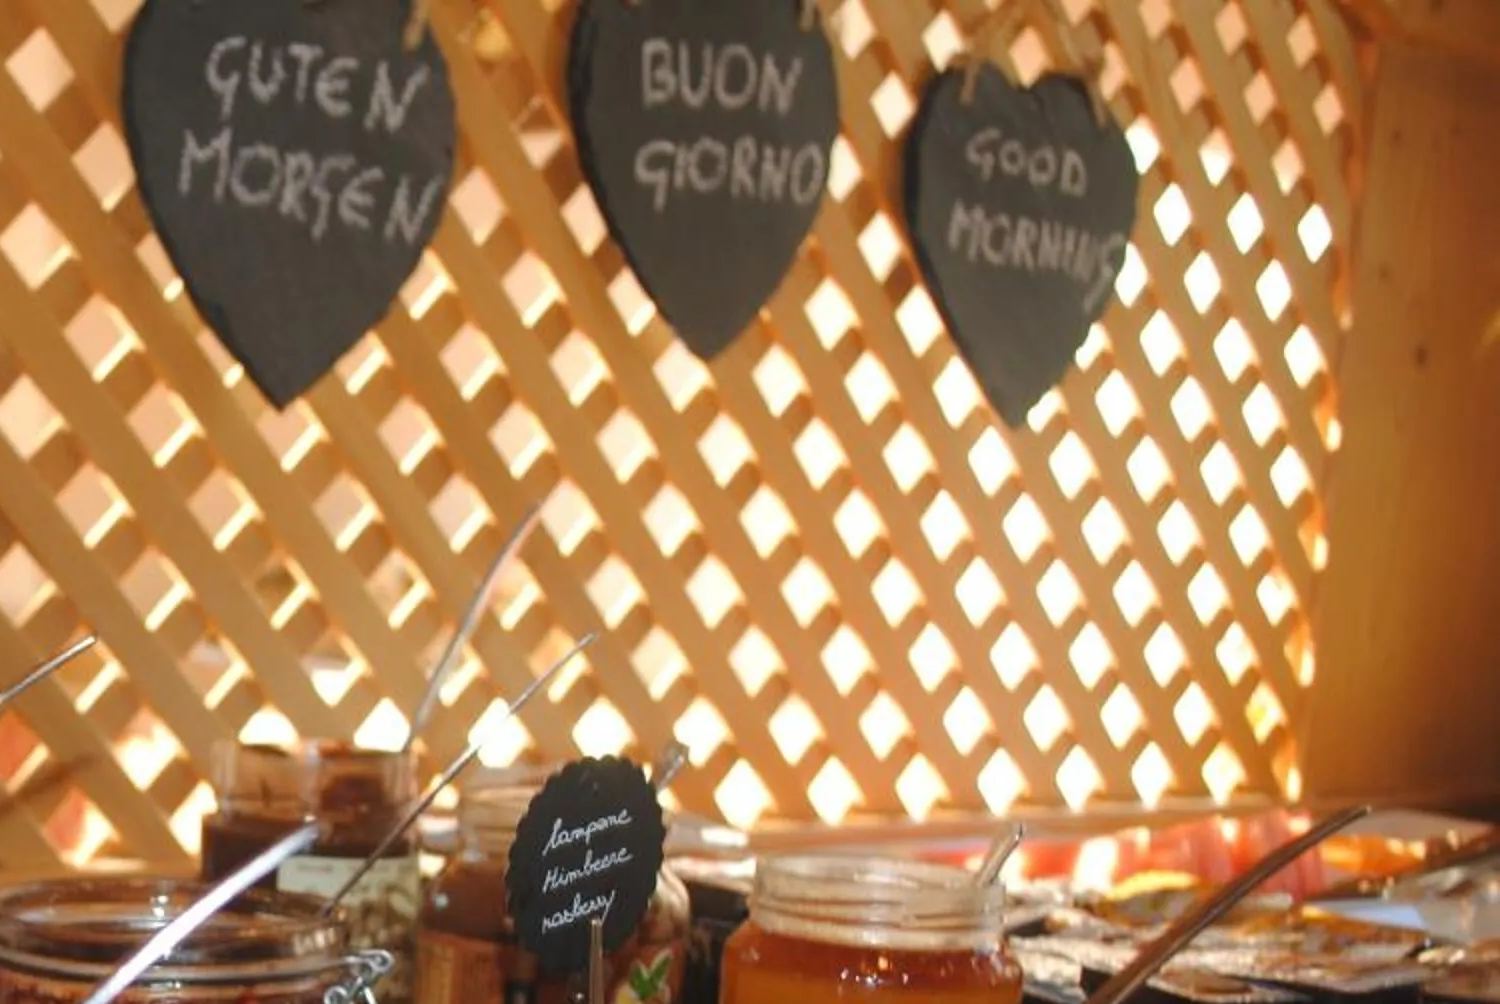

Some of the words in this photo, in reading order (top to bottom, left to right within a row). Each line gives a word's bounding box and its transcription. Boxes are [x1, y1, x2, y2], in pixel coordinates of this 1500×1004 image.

[206, 35, 430, 133] GUTEN
[641, 37, 803, 116] BUON
[178, 127, 443, 245] MORGEN
[634, 132, 825, 214] GIORNO
[965, 127, 1087, 198] GOOD
[542, 847, 633, 893] Himbeere
